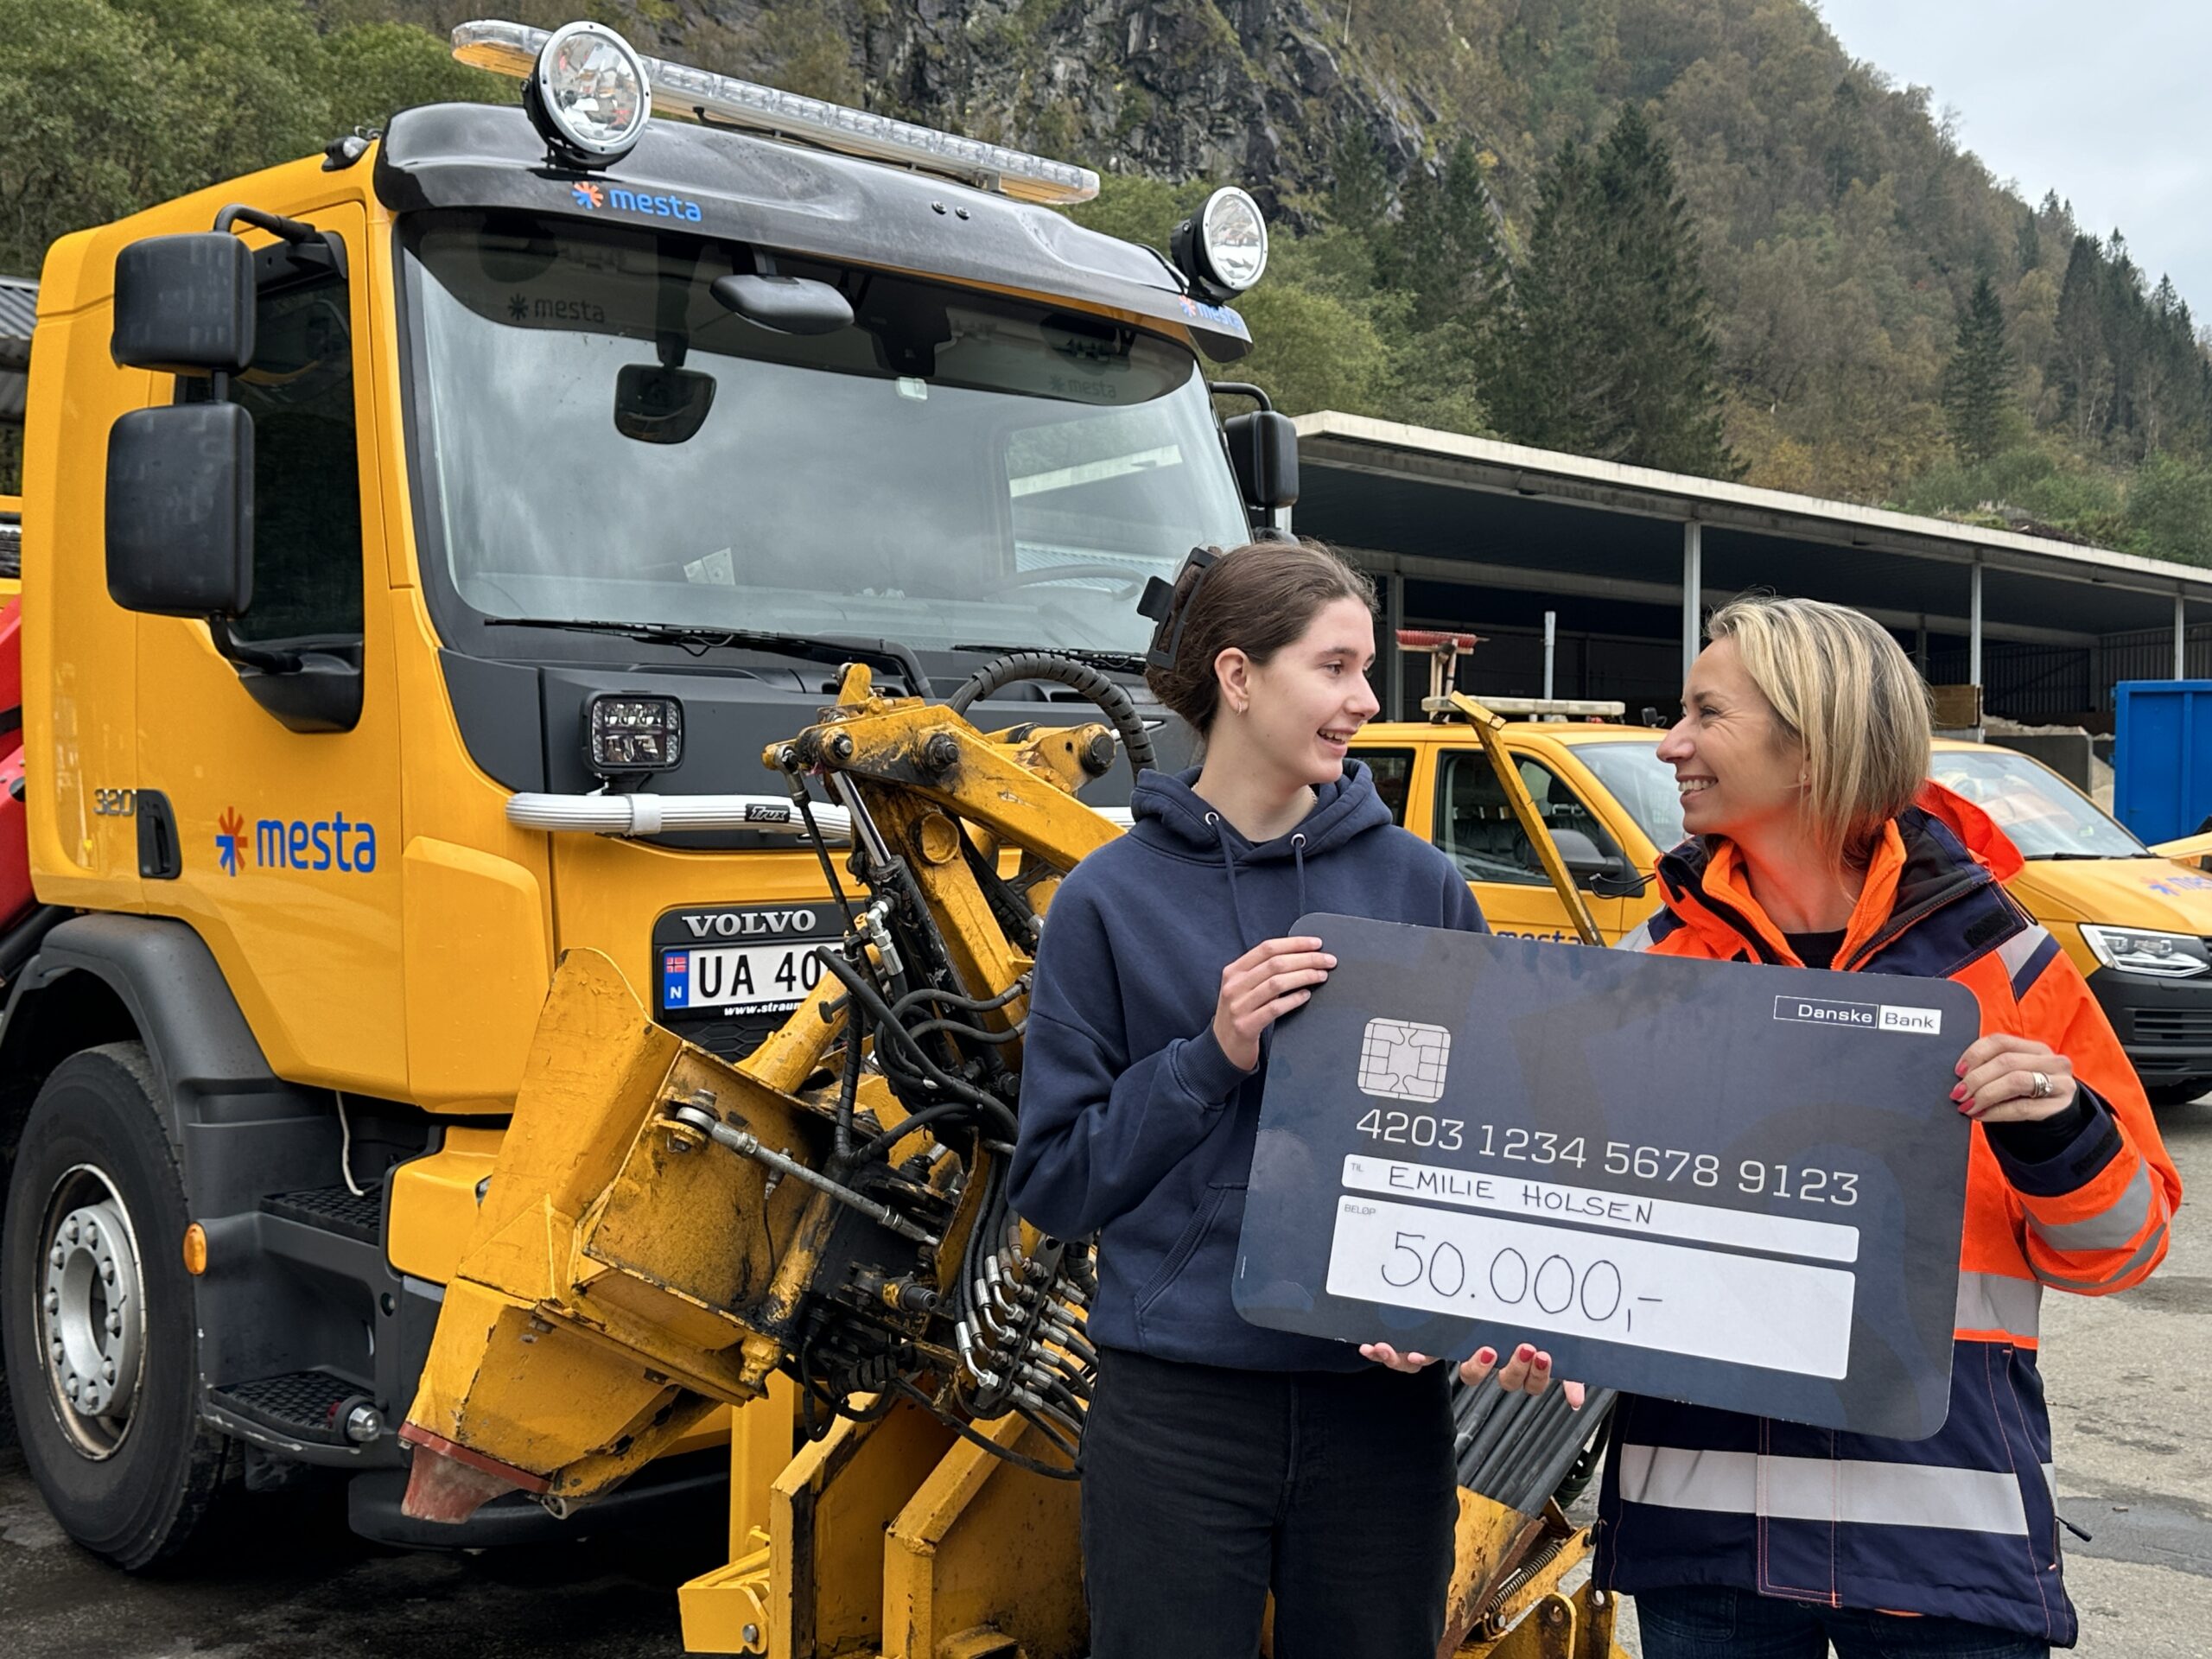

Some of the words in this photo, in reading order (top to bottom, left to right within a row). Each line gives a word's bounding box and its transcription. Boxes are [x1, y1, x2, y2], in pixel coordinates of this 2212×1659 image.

[609, 189, 702, 222] mesta
[535, 298, 604, 323] mesta
[1068, 379, 1116, 398] mesta
[93, 788, 137, 817] 320
[749, 806, 788, 820] Trux
[256, 811, 376, 873] mesta
[682, 909, 817, 938] VOLVO
[698, 954, 755, 999] UA
[774, 950, 821, 993] 40
[670, 986, 683, 1000] N
[1798, 1004, 1873, 1023] Danske
[1885, 1012, 1934, 1029] Bank
[1351, 1162, 1364, 1173] TIL
[1356, 1109, 1465, 1151] 4203
[1478, 1124, 1587, 1169] 1234
[1604, 1141, 1720, 1187] 5678
[1738, 1160, 1859, 1206] 9123
[1389, 1165, 1496, 1199] EMILIE
[1522, 1184, 1653, 1225] HOLSEN
